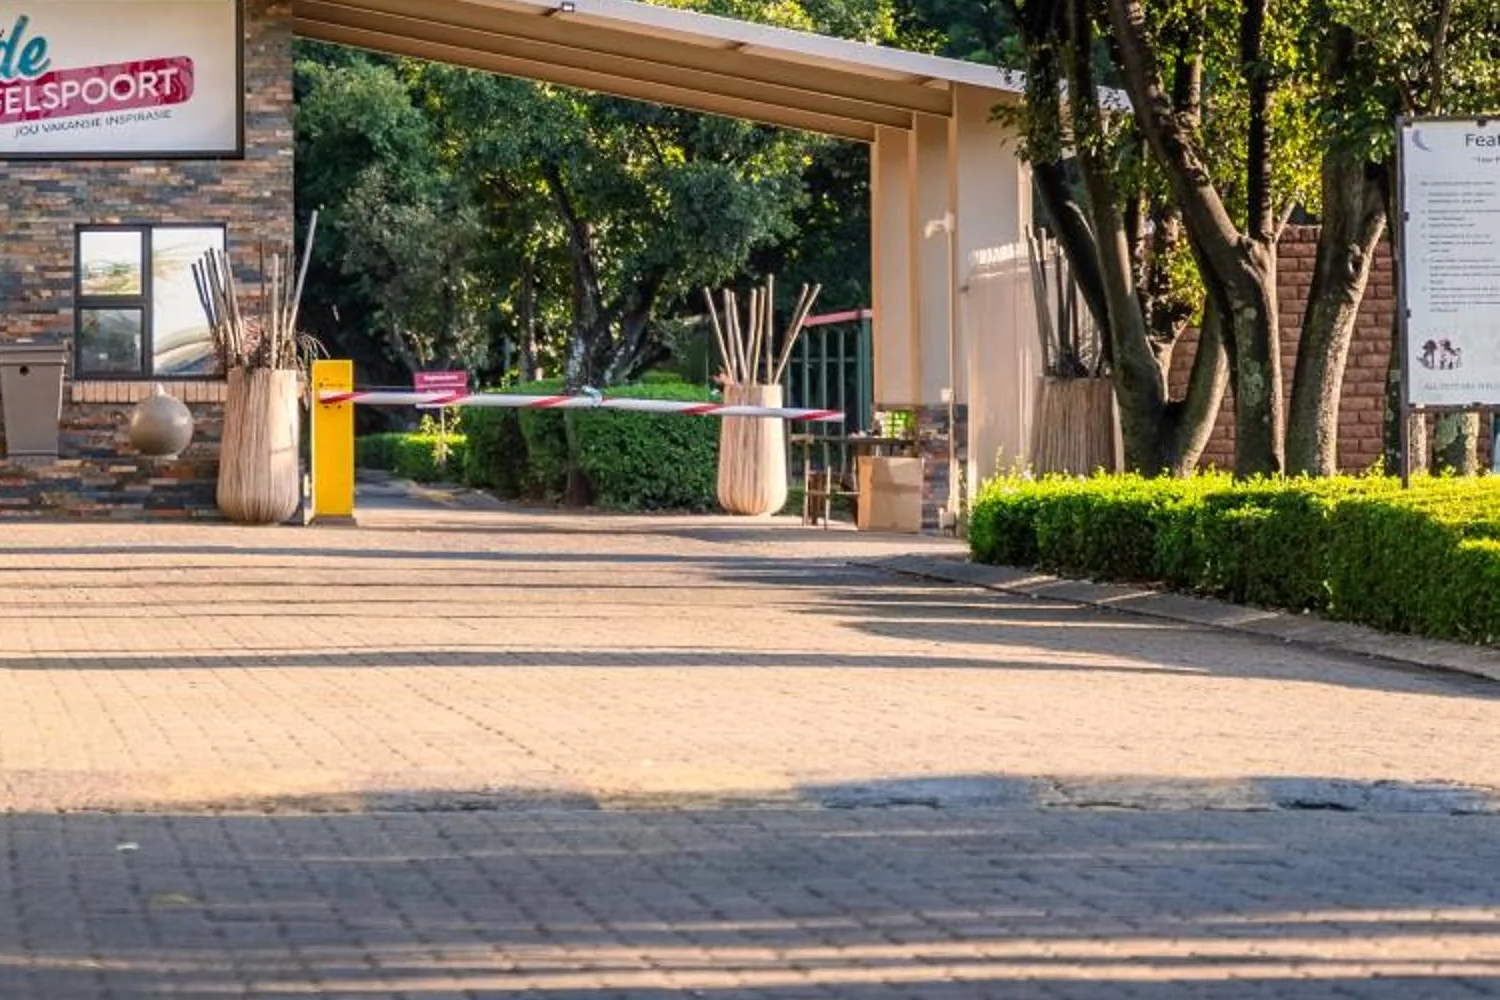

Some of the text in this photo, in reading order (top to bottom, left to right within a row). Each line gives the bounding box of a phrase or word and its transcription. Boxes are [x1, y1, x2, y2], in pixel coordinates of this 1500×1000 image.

[14, 109, 173, 138] JOU VAKANSIE INSPIRASIE
